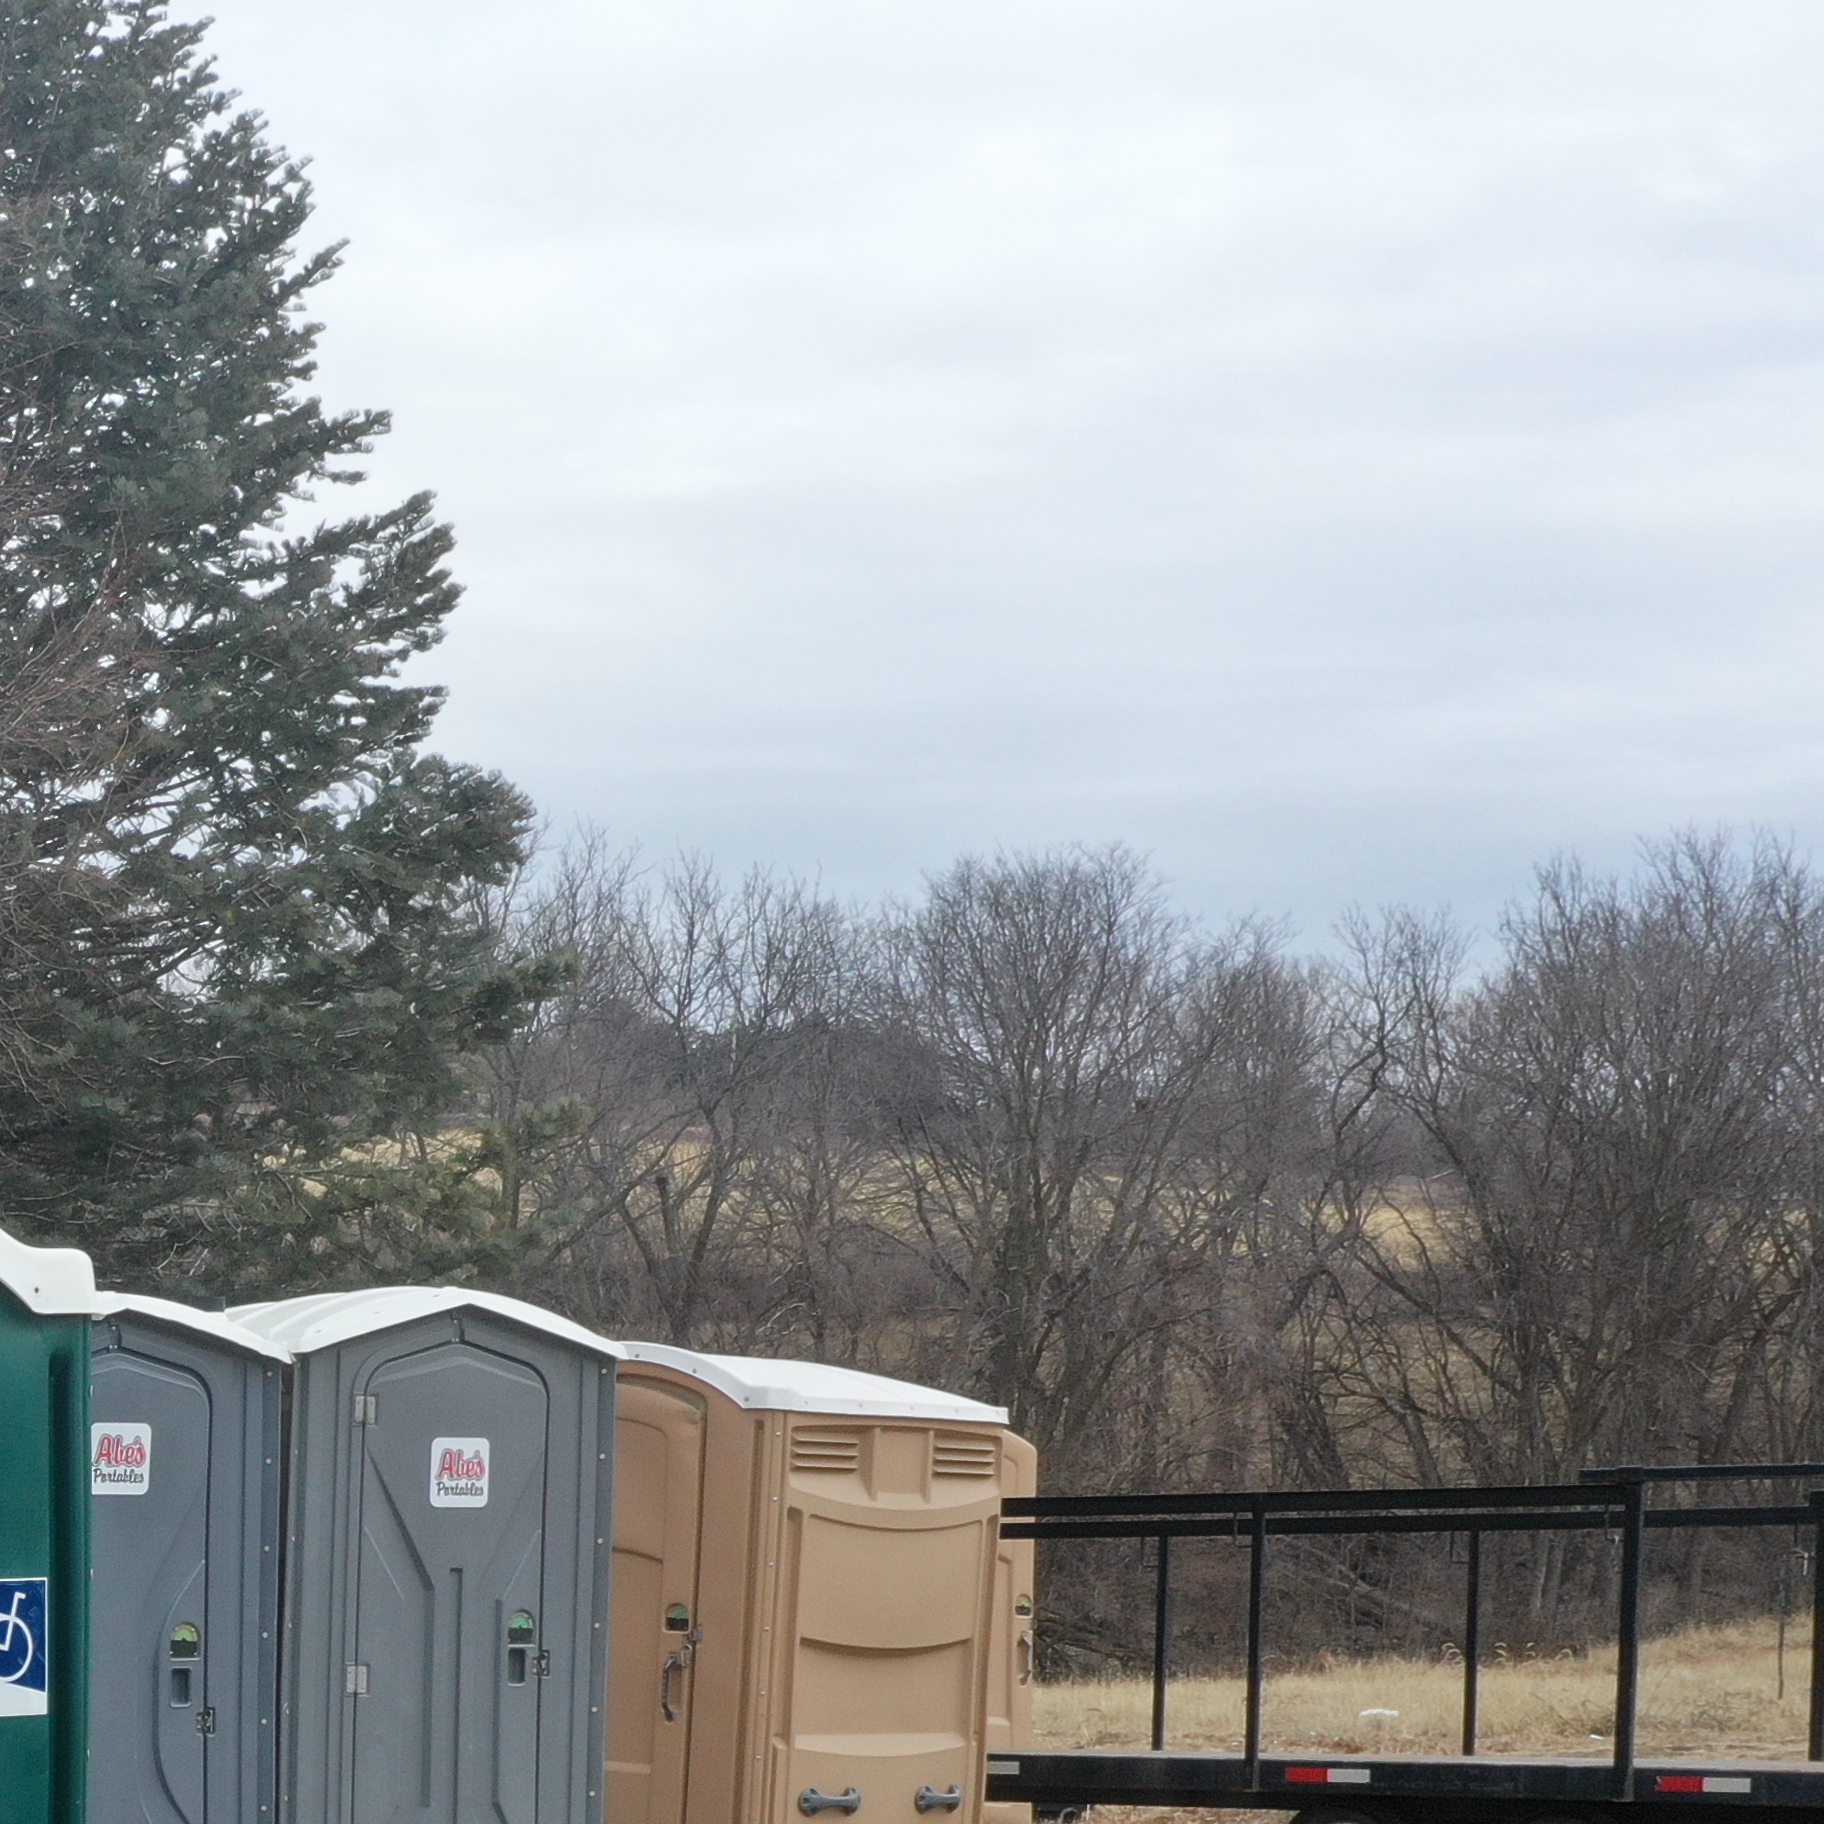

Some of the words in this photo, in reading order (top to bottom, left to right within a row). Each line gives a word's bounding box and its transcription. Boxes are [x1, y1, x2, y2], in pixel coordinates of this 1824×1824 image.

[91, 1433, 146, 1468] Abe's
[92, 1468, 145, 1484] Portables
[434, 1448, 485, 1482] Abe's
[436, 1481, 484, 1497] Portables
